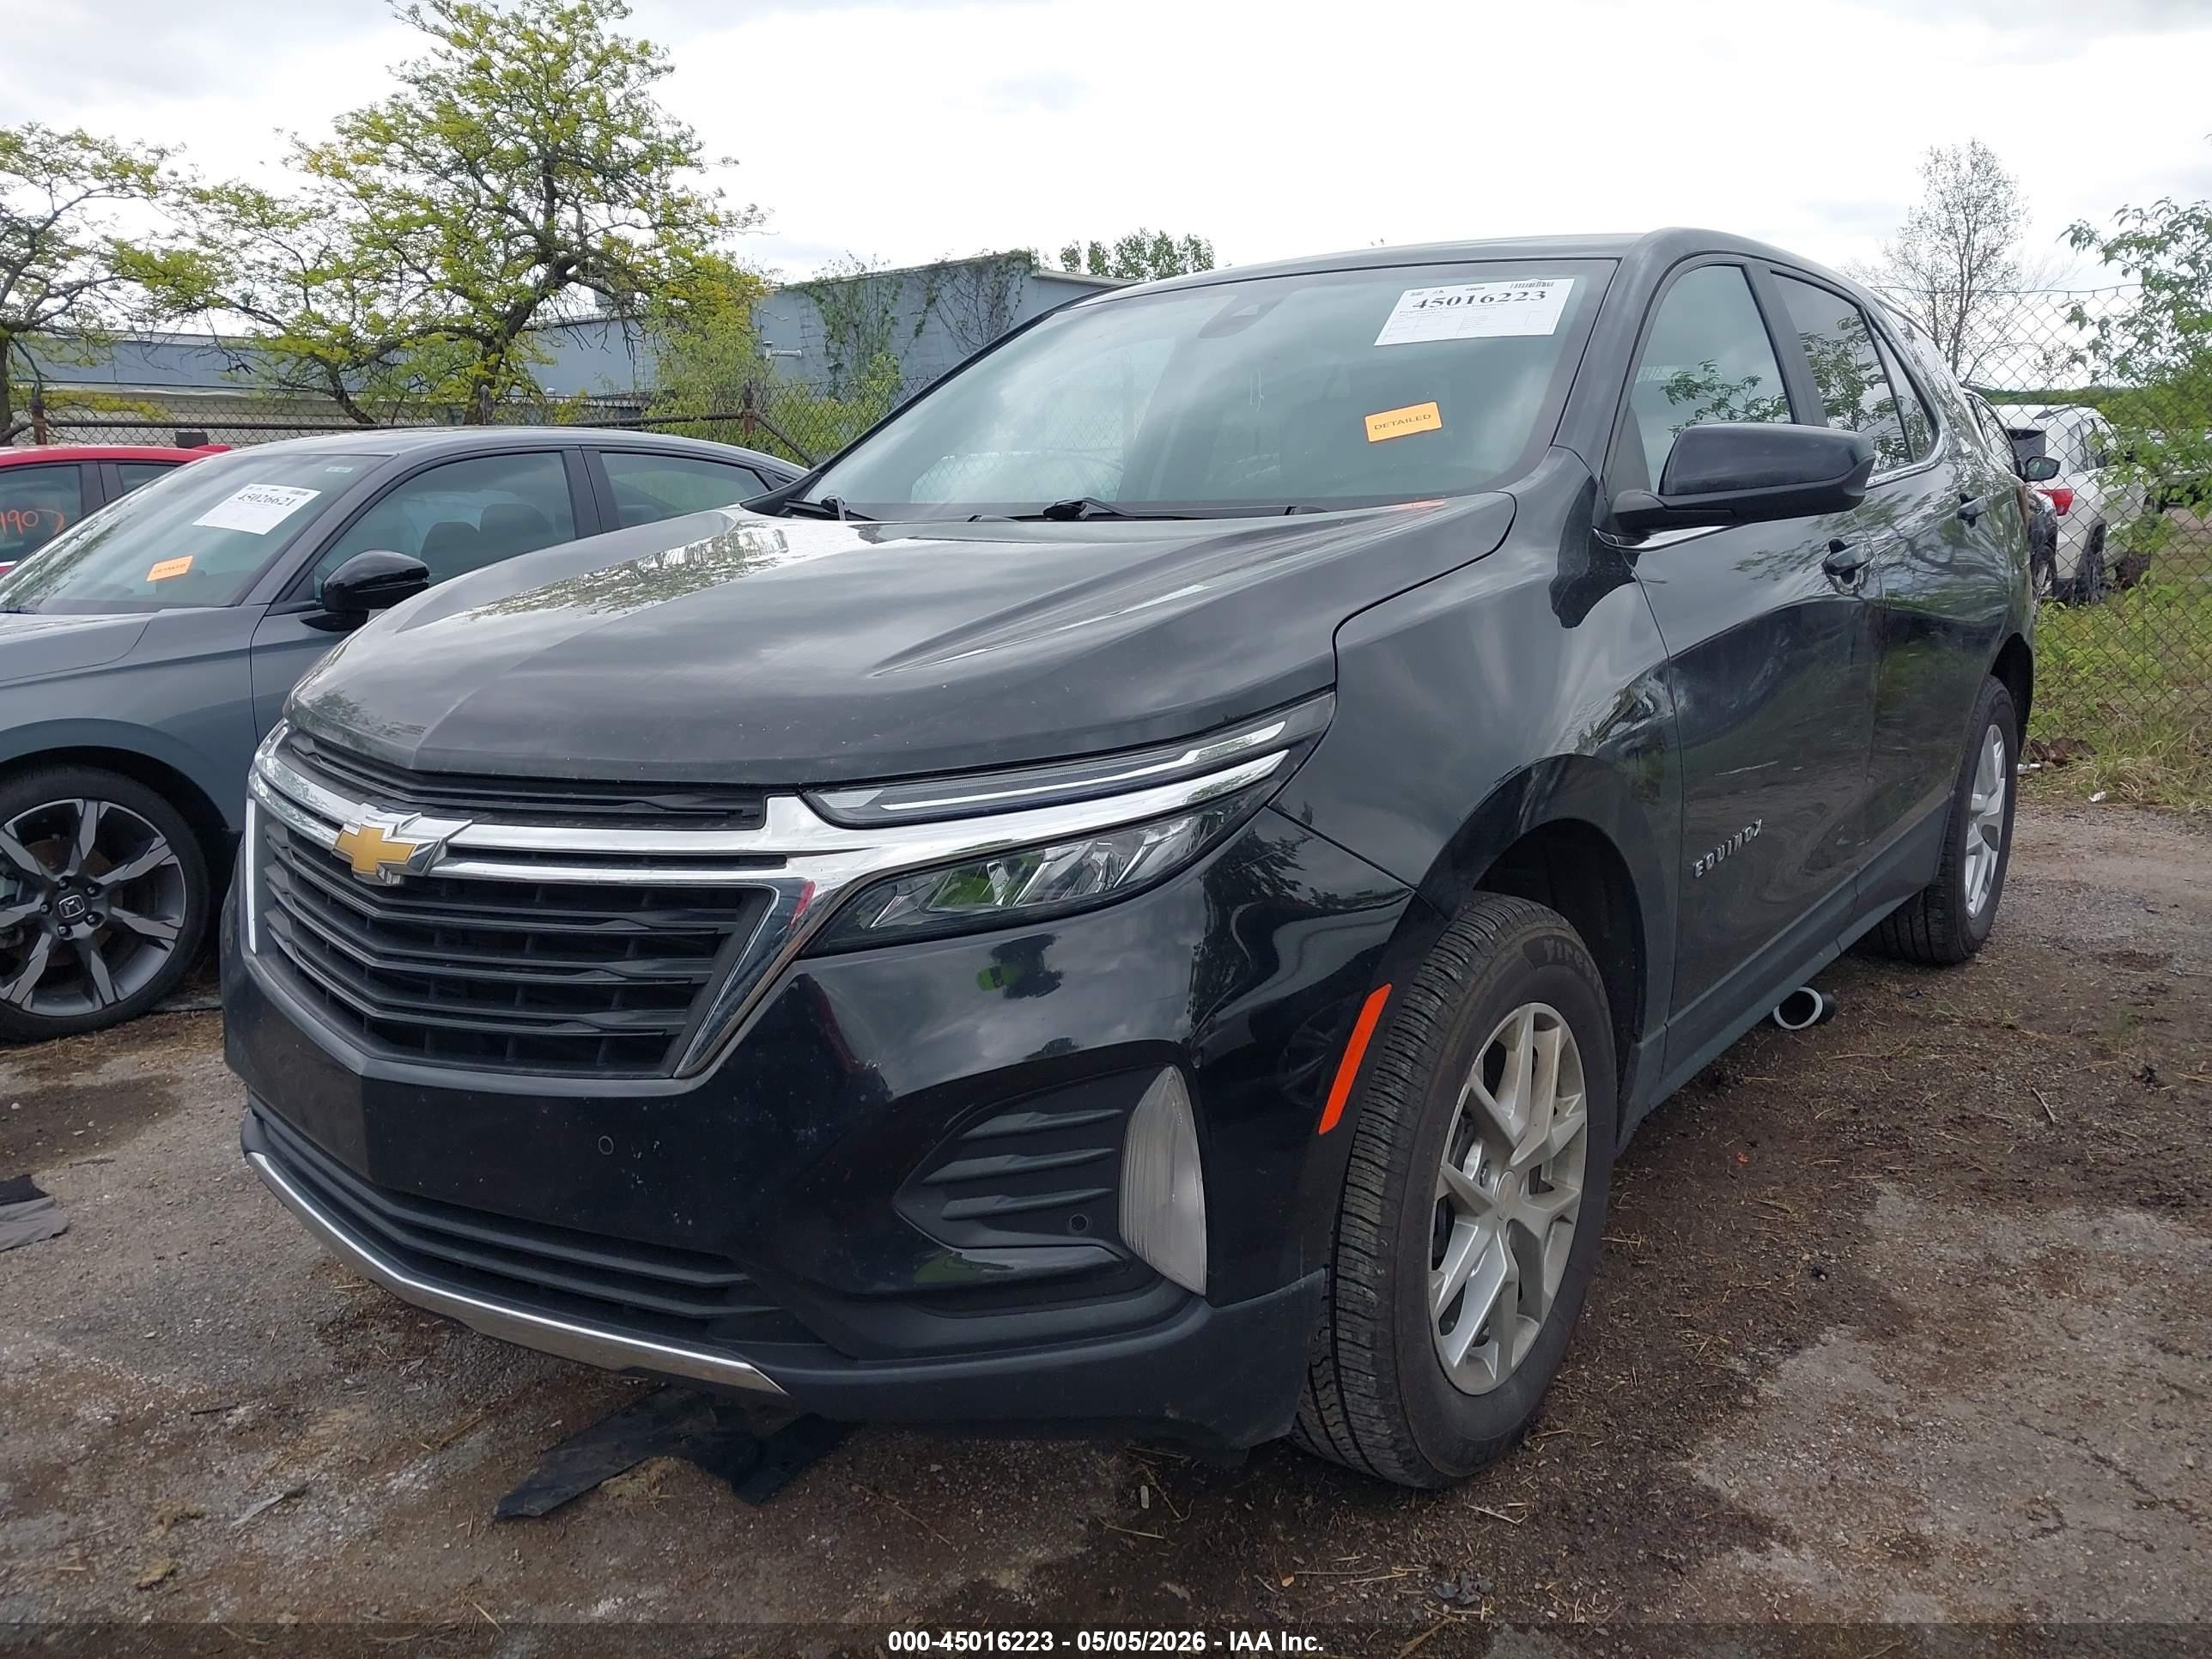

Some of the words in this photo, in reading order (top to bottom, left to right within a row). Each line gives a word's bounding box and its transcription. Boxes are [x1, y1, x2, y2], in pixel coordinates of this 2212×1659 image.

[1412, 290, 1547, 310] 45016223
[1373, 413, 1432, 430] DETAILED
[237, 492, 298, 507] 45026621
[1692, 817, 1763, 878] EQUINOX
